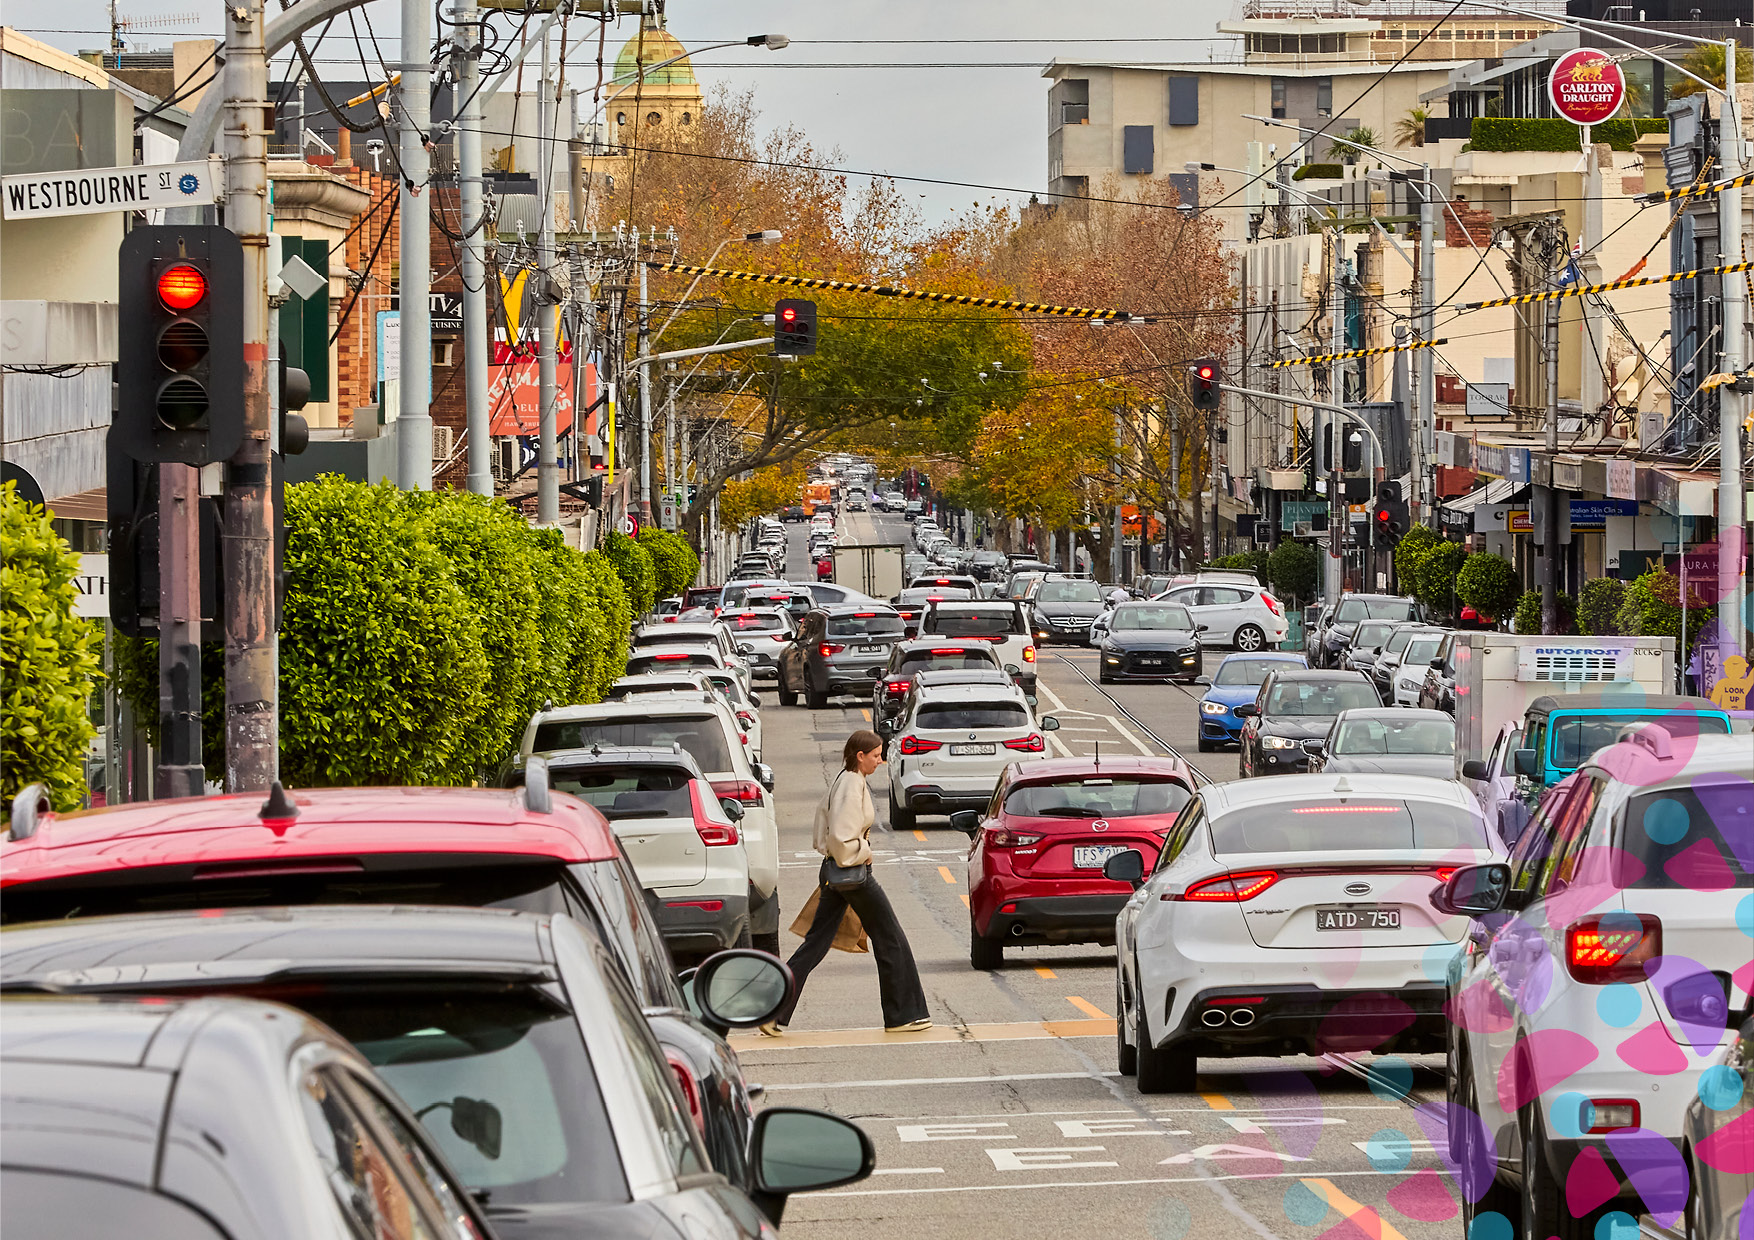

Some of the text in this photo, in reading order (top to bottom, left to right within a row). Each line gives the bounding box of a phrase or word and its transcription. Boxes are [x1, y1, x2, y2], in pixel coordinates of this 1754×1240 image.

[1560, 83, 1615, 93] CARLTON
[1563, 94, 1613, 102] DRAUGHT
[9, 172, 171, 211] WESTBOURNE ST
[1536, 648, 1621, 656] AUTOFROST
